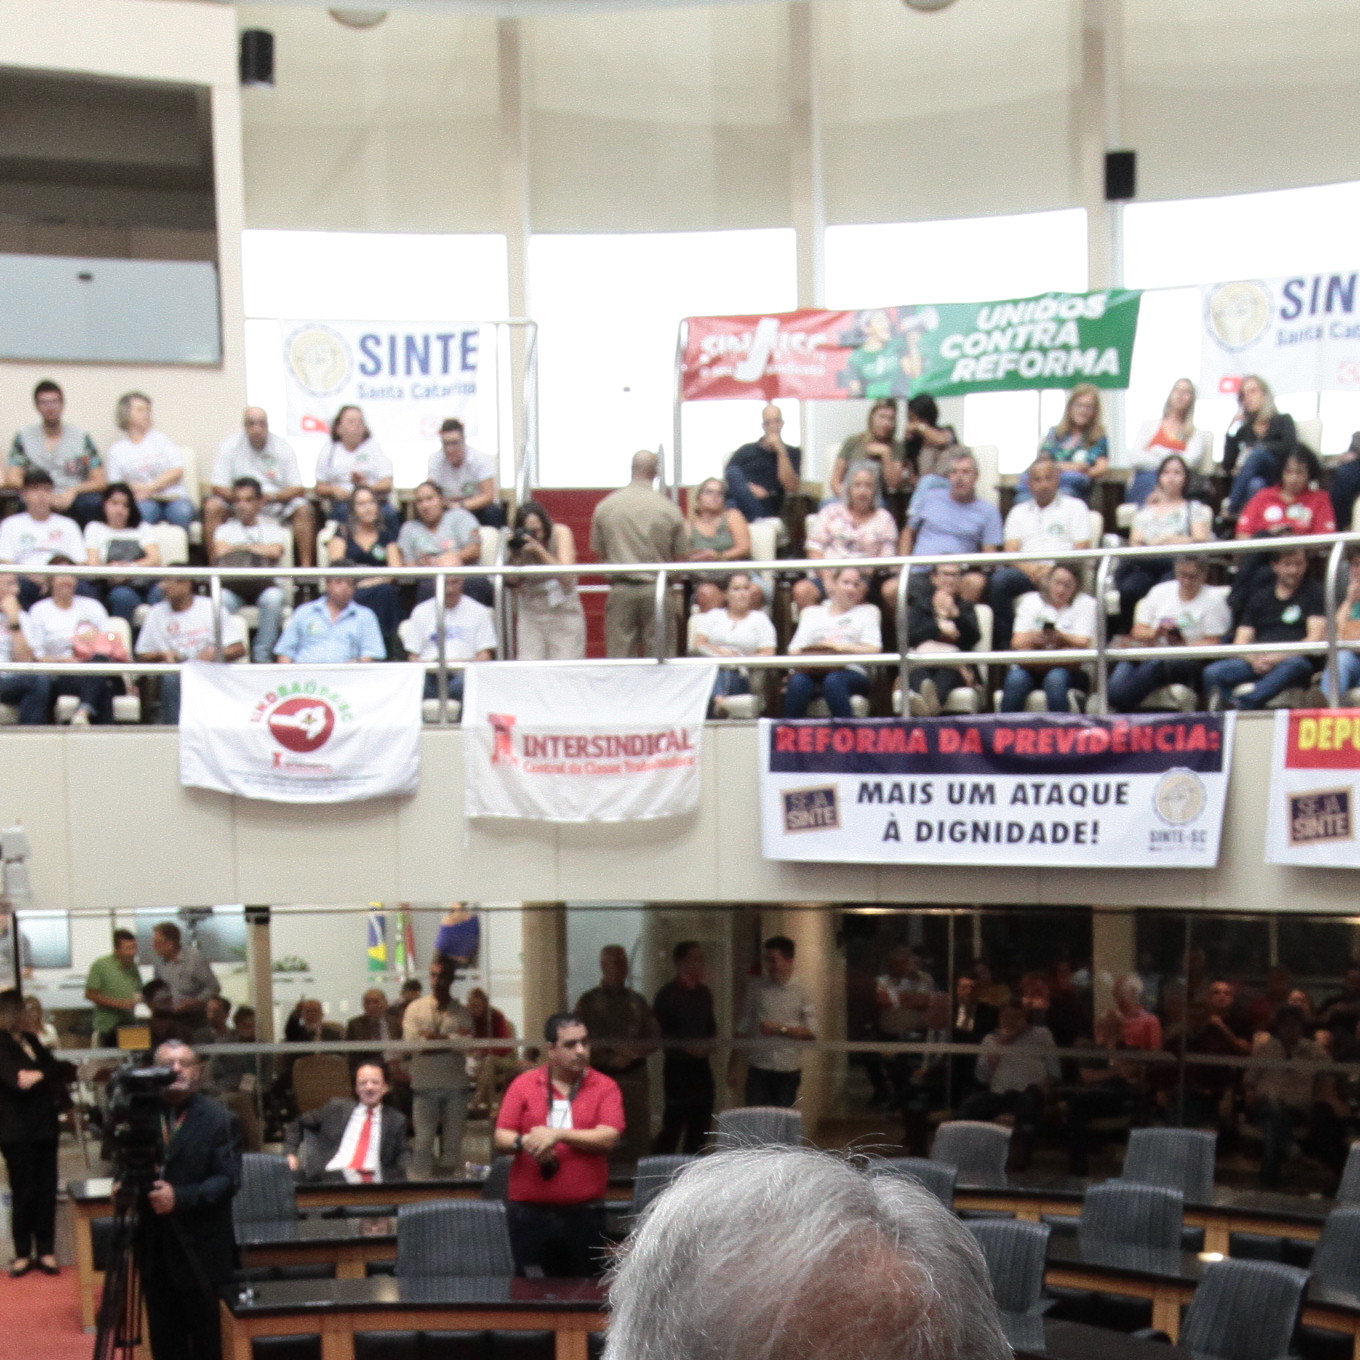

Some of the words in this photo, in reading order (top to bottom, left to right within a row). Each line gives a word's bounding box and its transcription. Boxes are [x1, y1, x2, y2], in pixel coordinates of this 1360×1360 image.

[977, 294, 1109, 331] UNIDOS
[940, 319, 1080, 359] CONTRA
[1276, 326, 1323, 346] Santa
[359, 331, 479, 376] SINTE
[950, 347, 1120, 382] REFORMA
[356, 382, 404, 400] Santa
[411, 379, 478, 400] Catarina
[522, 728, 695, 759] INTERSINDICAL
[775, 725, 928, 753] REFORMA
[939, 727, 984, 754] DA
[993, 720, 1221, 754] PREVIDÊNCIA:
[857, 781, 934, 804] MAIS
[947, 781, 995, 804] UM
[1010, 782, 1130, 807] ATAQUE
[883, 812, 901, 841] À
[916, 819, 1099, 845] DIGNIDADE!
